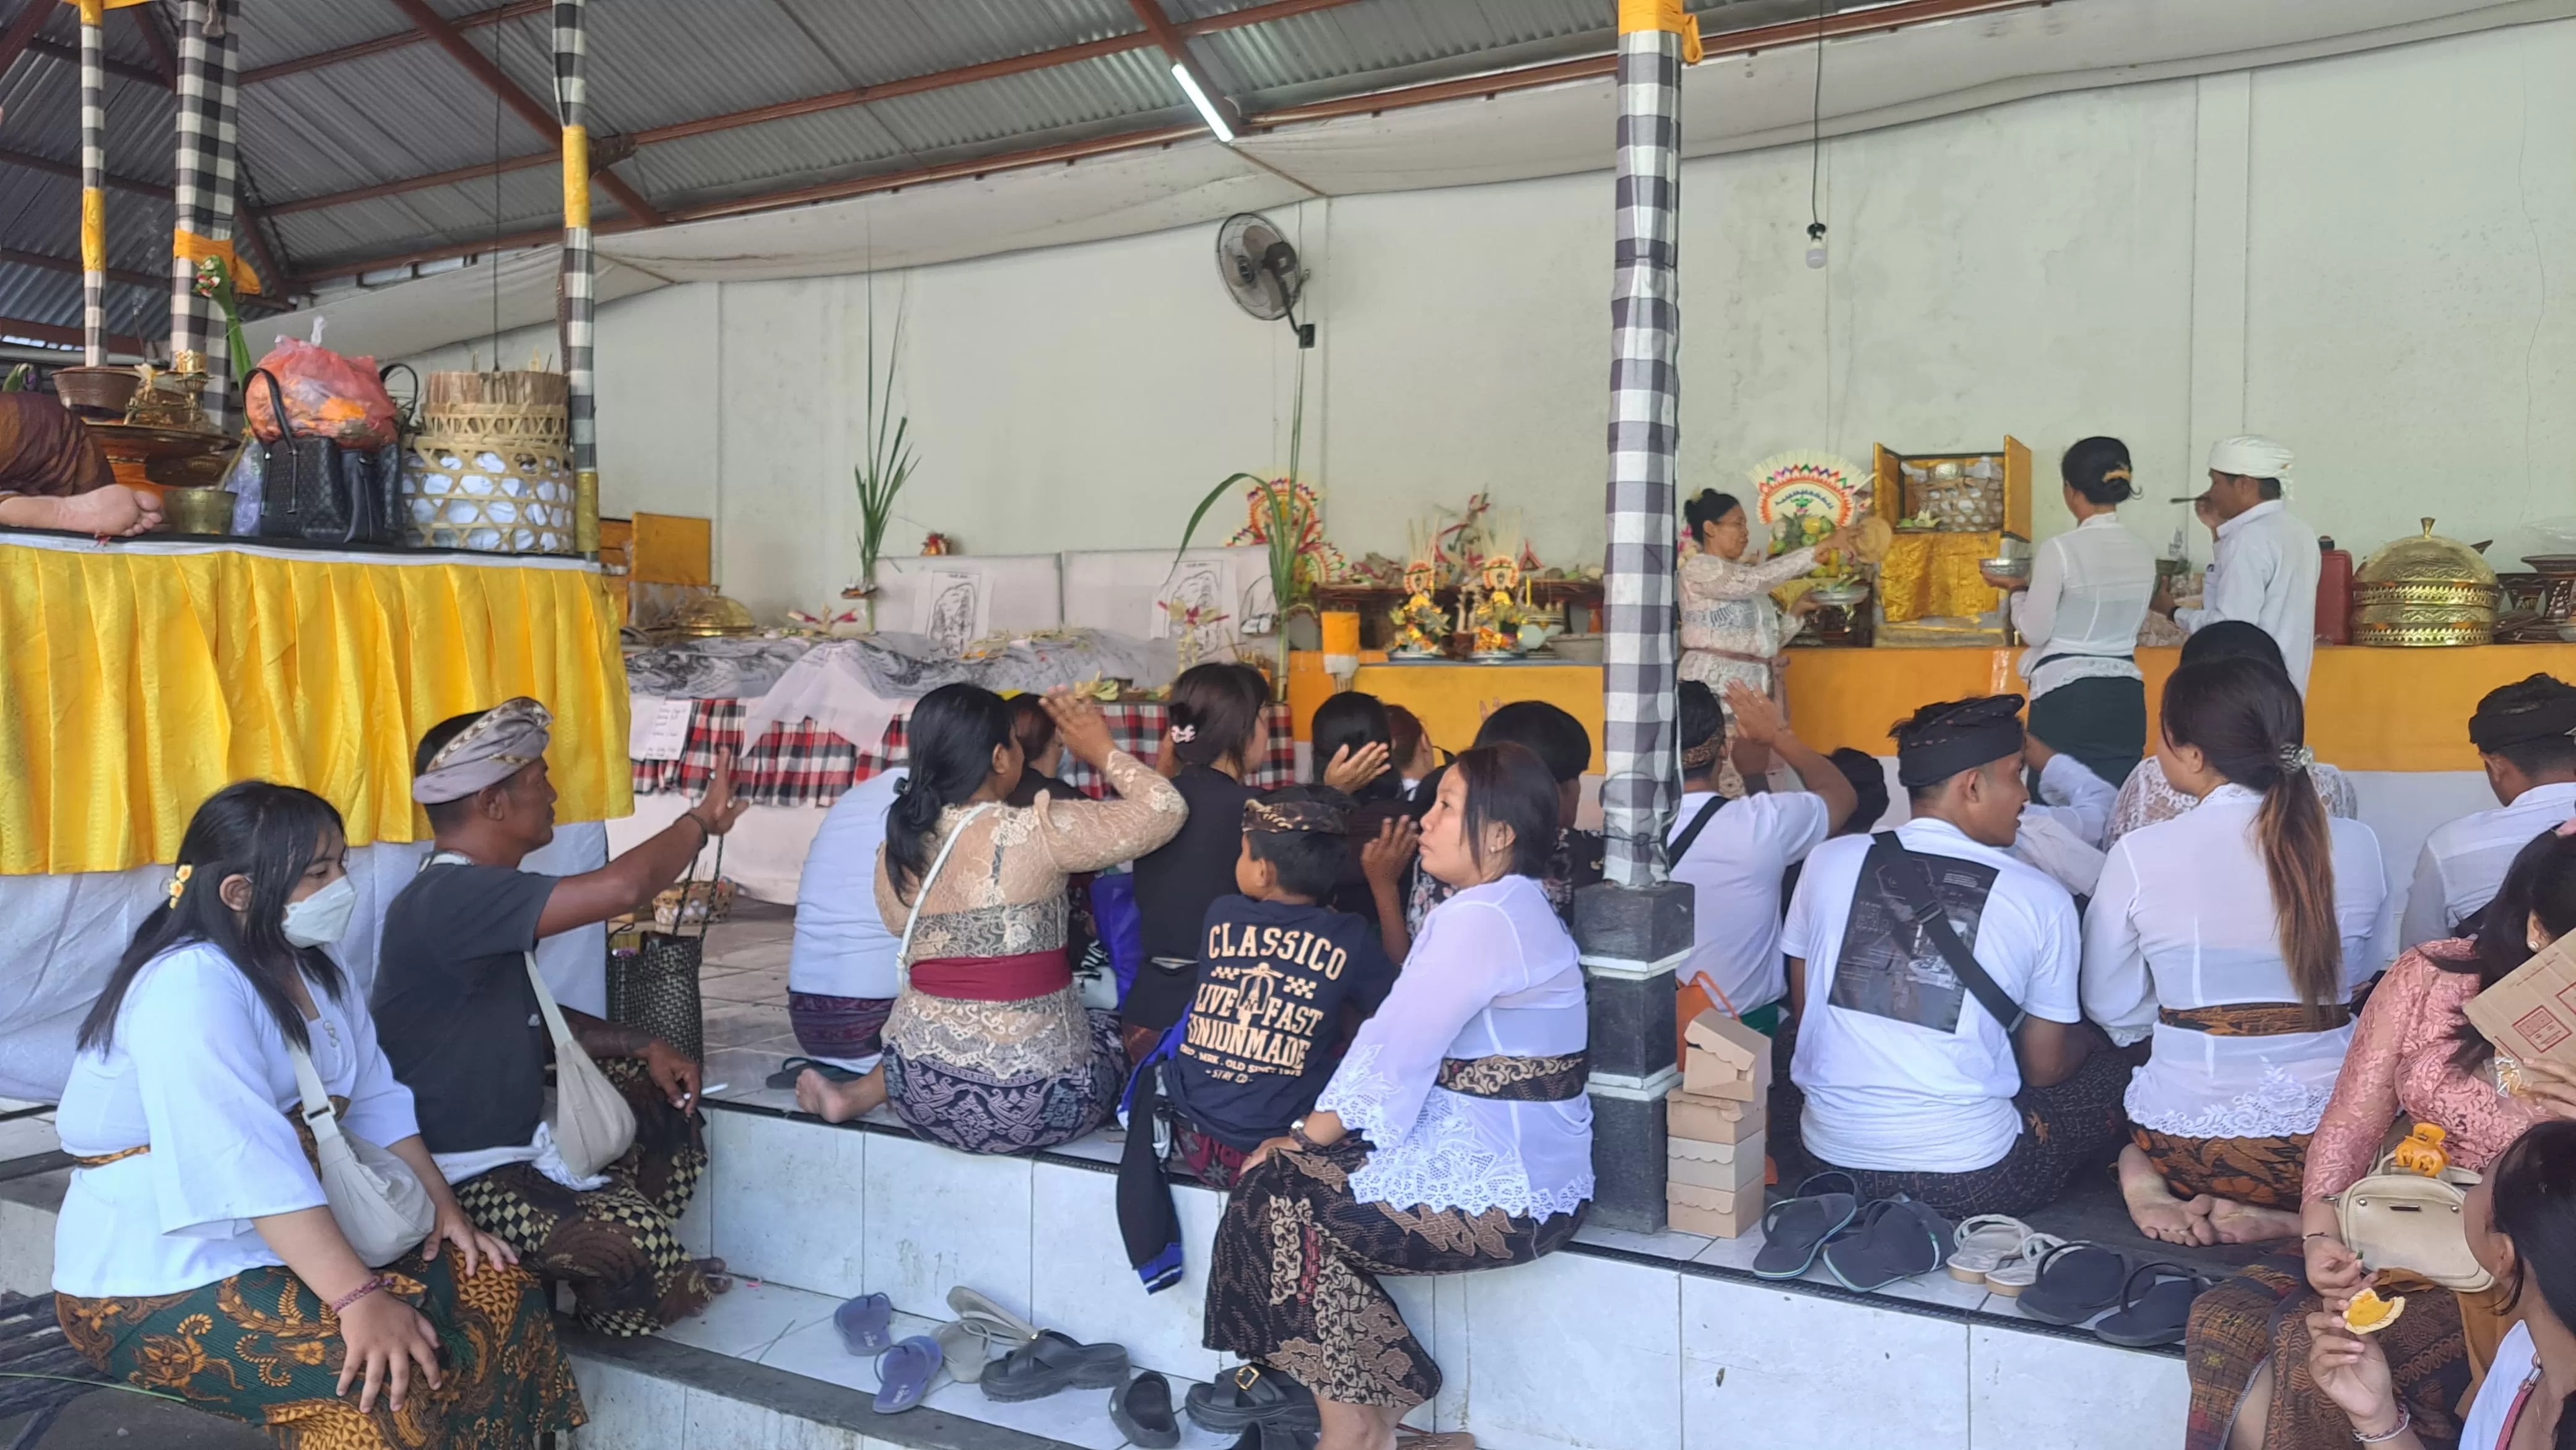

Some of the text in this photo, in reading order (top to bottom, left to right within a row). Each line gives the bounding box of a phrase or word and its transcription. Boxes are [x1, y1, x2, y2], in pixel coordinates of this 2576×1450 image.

[1209, 922, 1347, 981] CLASSICO
[1193, 983, 1324, 1036] LIVE FAST
[1187, 1014, 1312, 1070] UNIONMADE
[1224, 1058, 1246, 1071] OLD
